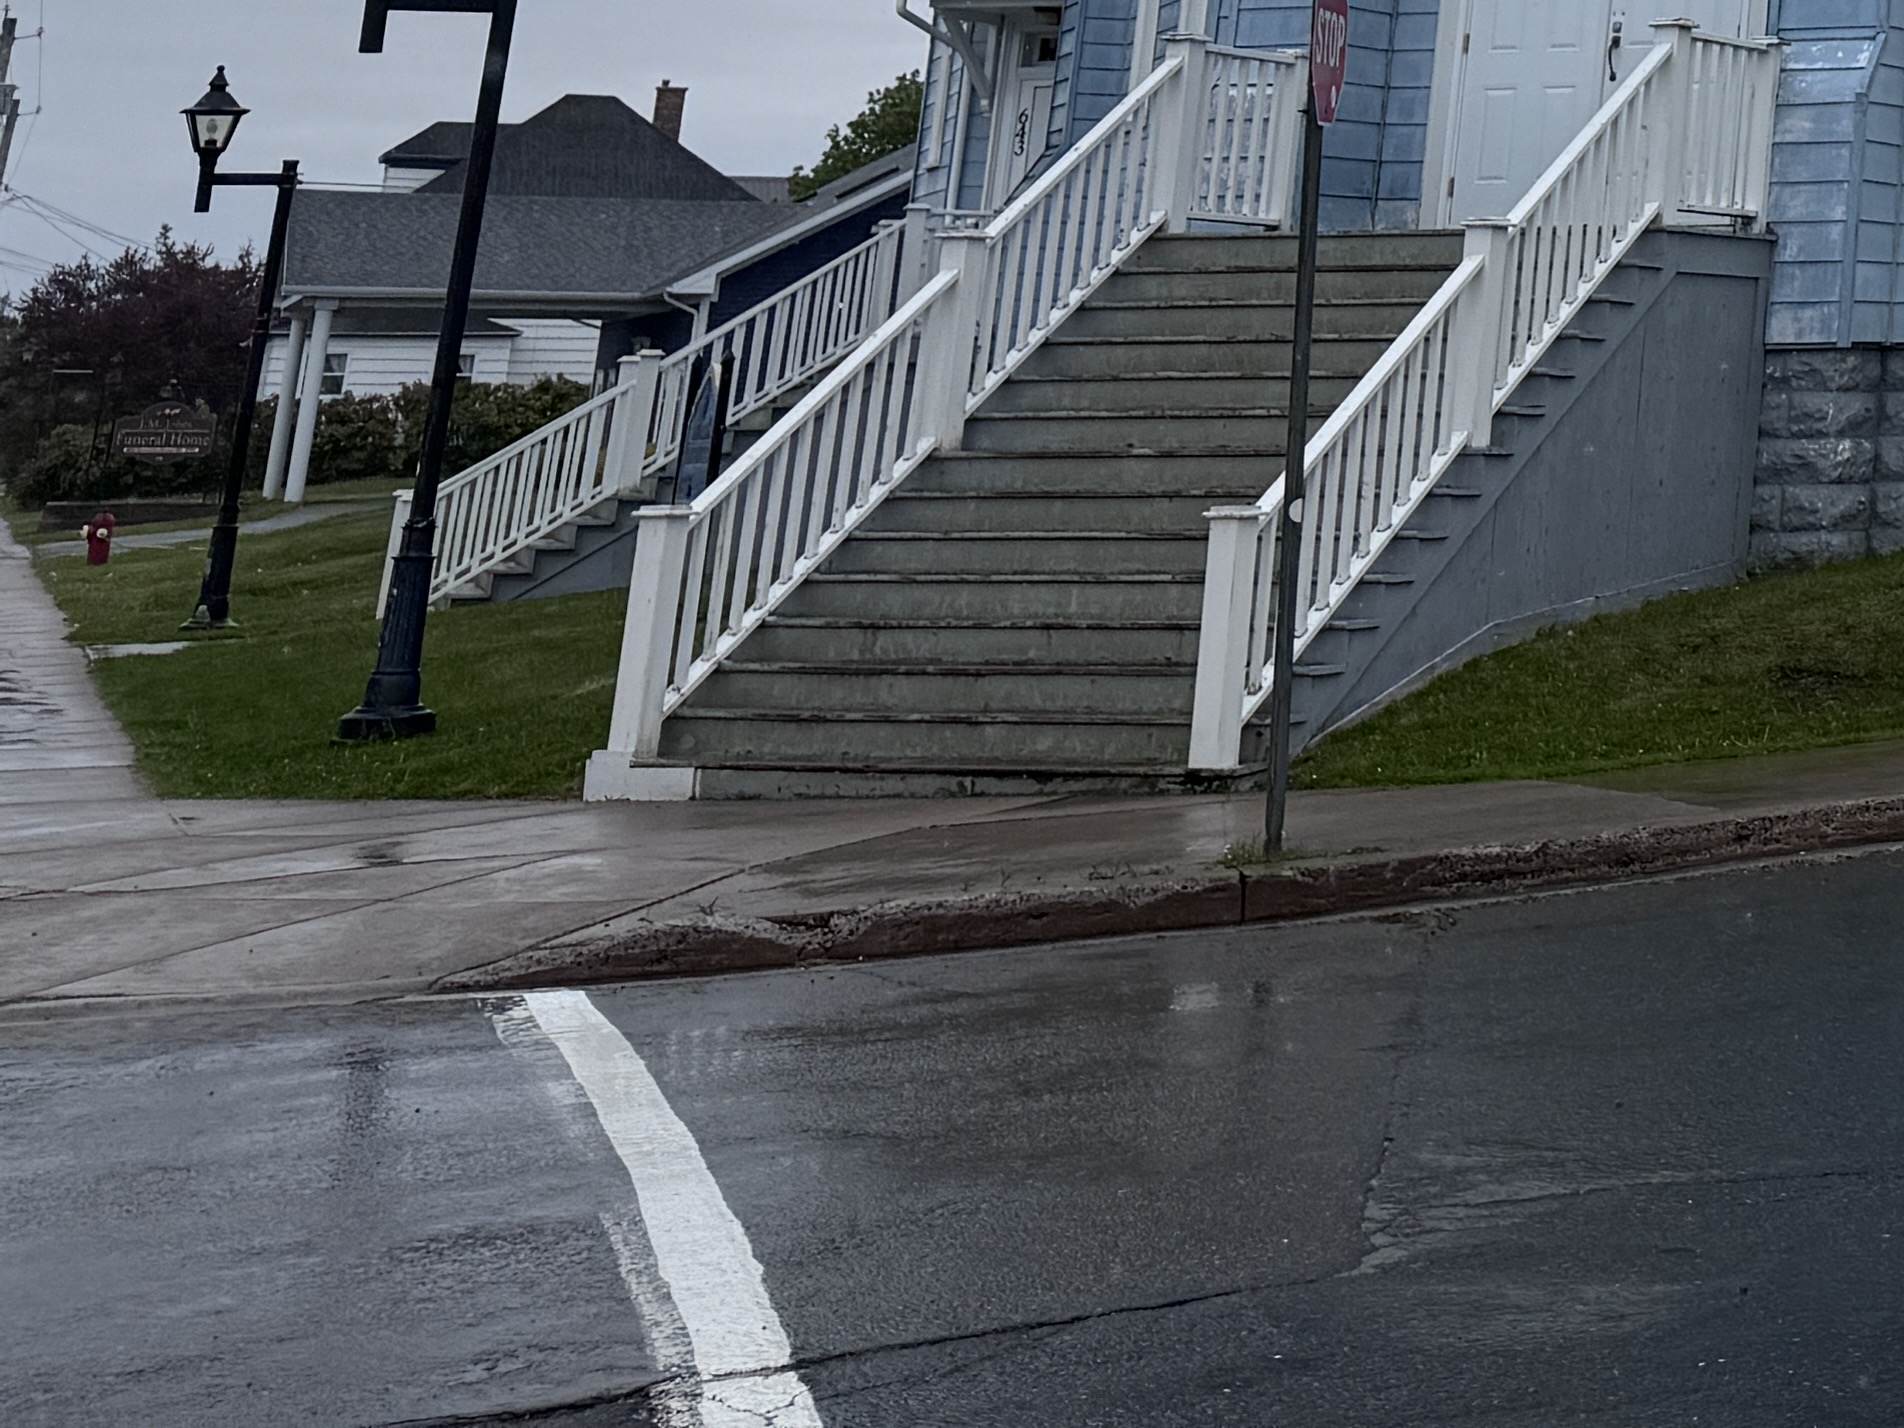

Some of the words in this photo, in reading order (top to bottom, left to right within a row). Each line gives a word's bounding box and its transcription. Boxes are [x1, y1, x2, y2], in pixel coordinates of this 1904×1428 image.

[1316, 7, 1346, 68] STOP
[1014, 108, 1028, 157] 643
[117, 431, 166, 446] Funeral
[170, 431, 211, 446] Home
